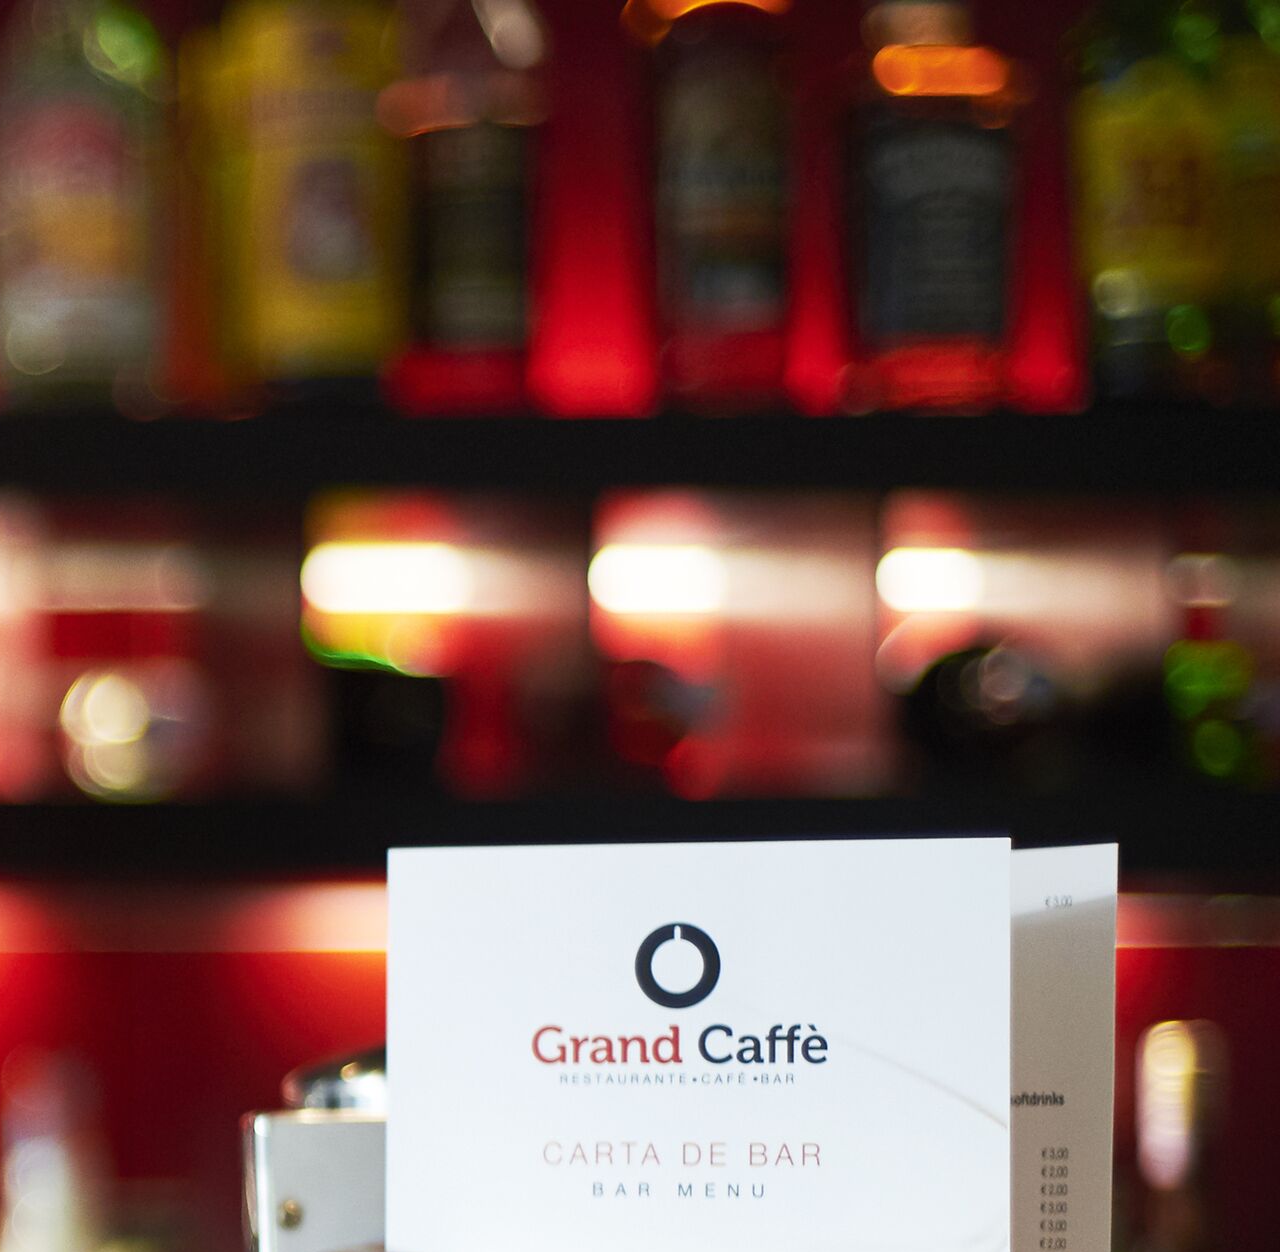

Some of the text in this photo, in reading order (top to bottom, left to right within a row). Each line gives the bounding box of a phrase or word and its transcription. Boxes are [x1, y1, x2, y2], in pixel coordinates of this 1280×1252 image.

[531, 1024, 829, 1064] Grand Caffè
[559, 1072, 688, 1085] RESTAURANTE
[760, 1072, 796, 1085] BAR
[542, 1142, 822, 1167] CARTA DE BAR
[592, 1182, 766, 1199] BAR MENU
